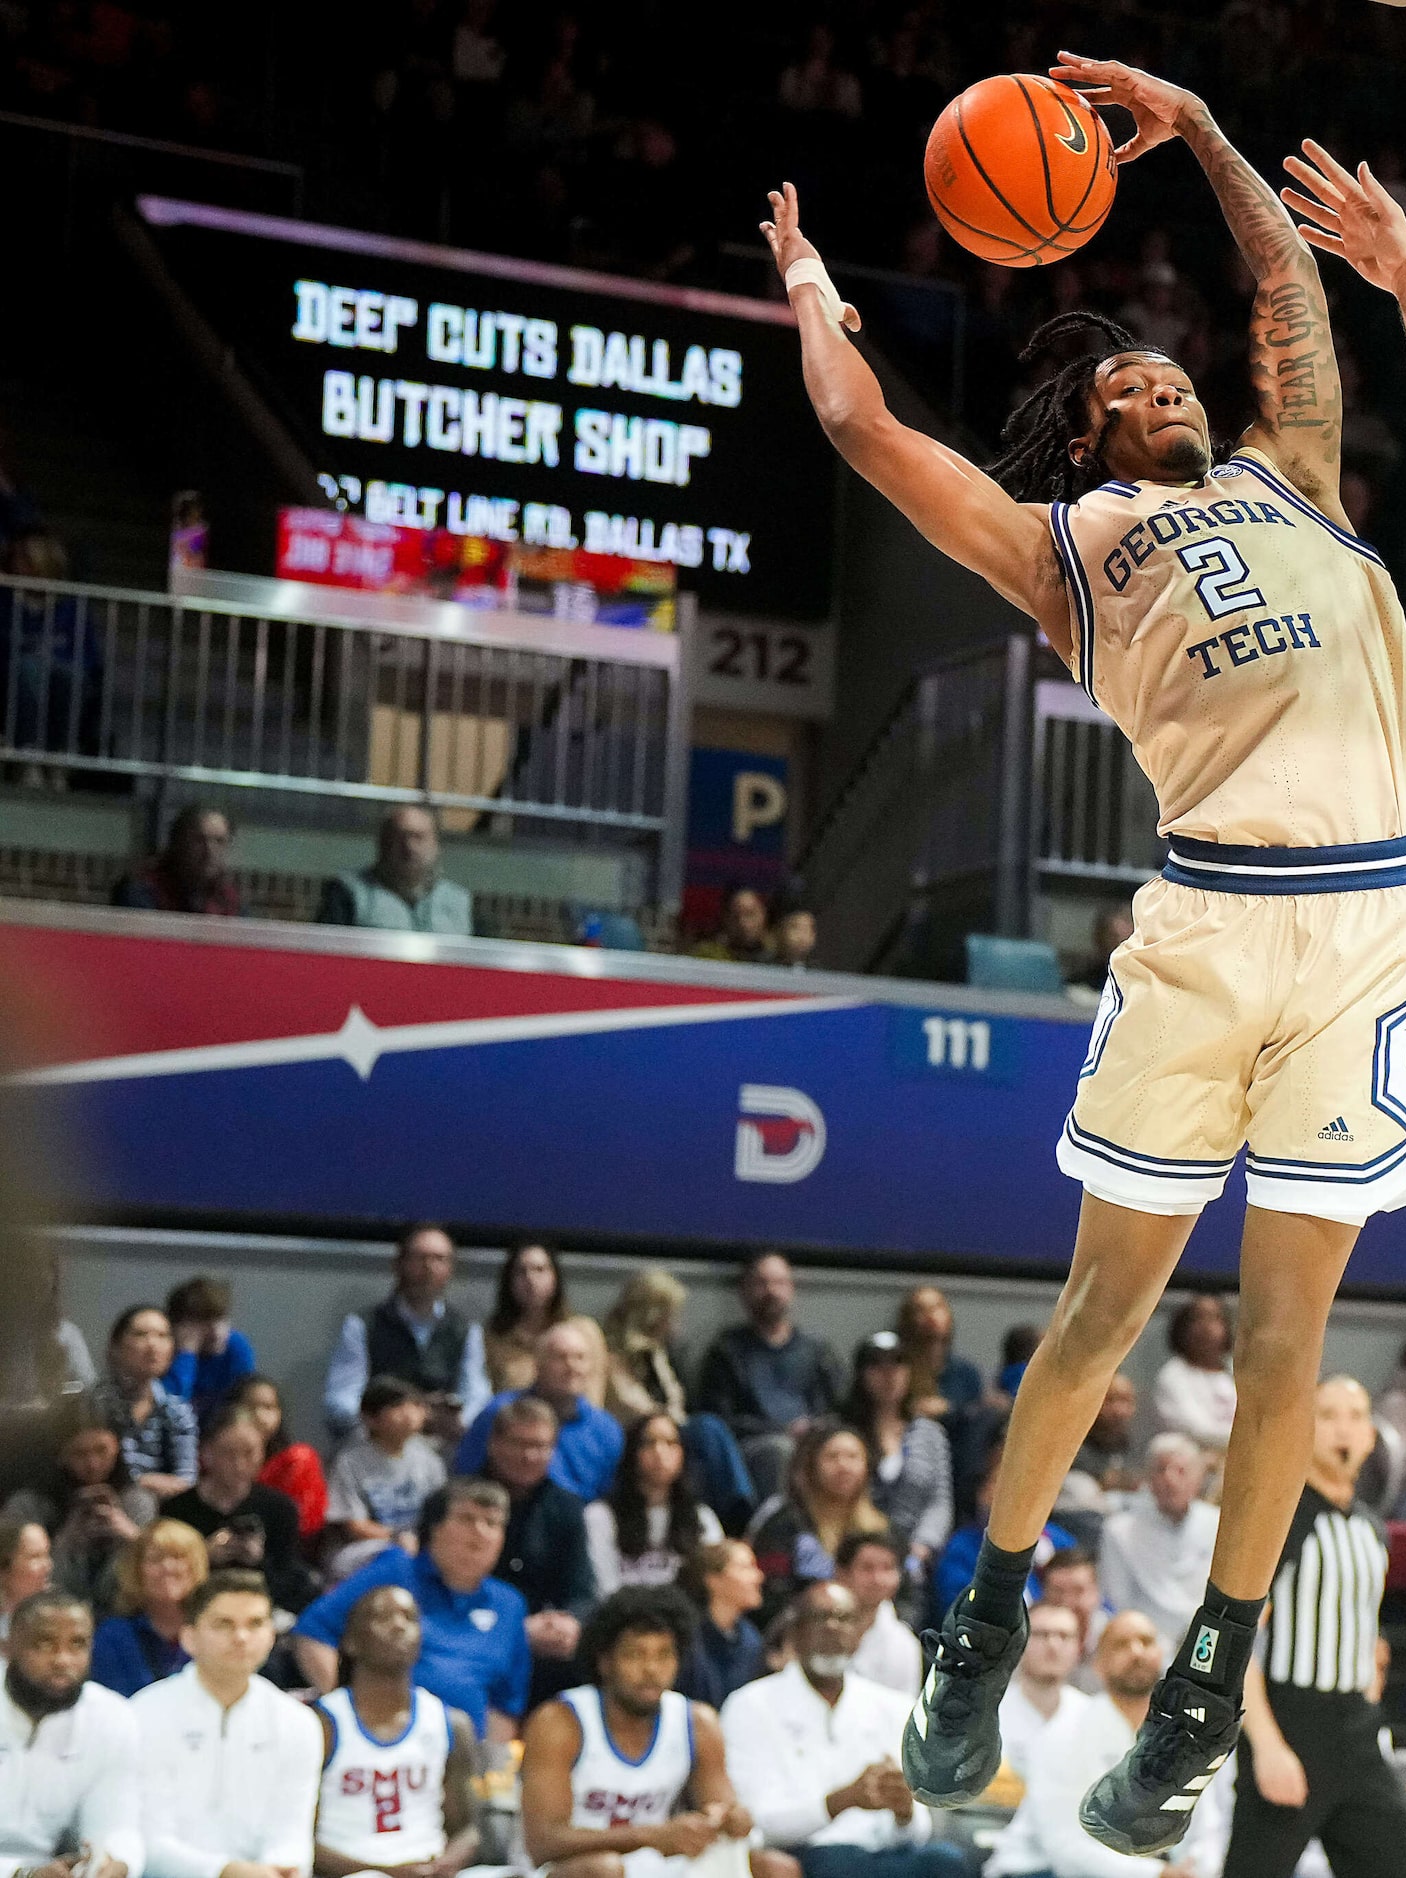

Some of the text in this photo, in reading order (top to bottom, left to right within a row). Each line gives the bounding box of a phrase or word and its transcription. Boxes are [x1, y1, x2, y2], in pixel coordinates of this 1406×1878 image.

[291, 278, 743, 408] DEEP CUTS DALLAS
[1264, 282, 1329, 430] FEAR GOD
[322, 369, 712, 487] BUTCHER SHOP
[706, 526, 750, 574] TX
[1103, 500, 1297, 592] GEORGIA
[1175, 535, 1267, 622] 2
[709, 629, 812, 686] 212
[1186, 613, 1322, 680] TECH
[922, 1016, 991, 1070] 111
[1317, 1131, 1355, 1142] adidas
[342, 1766, 427, 1796] SMU
